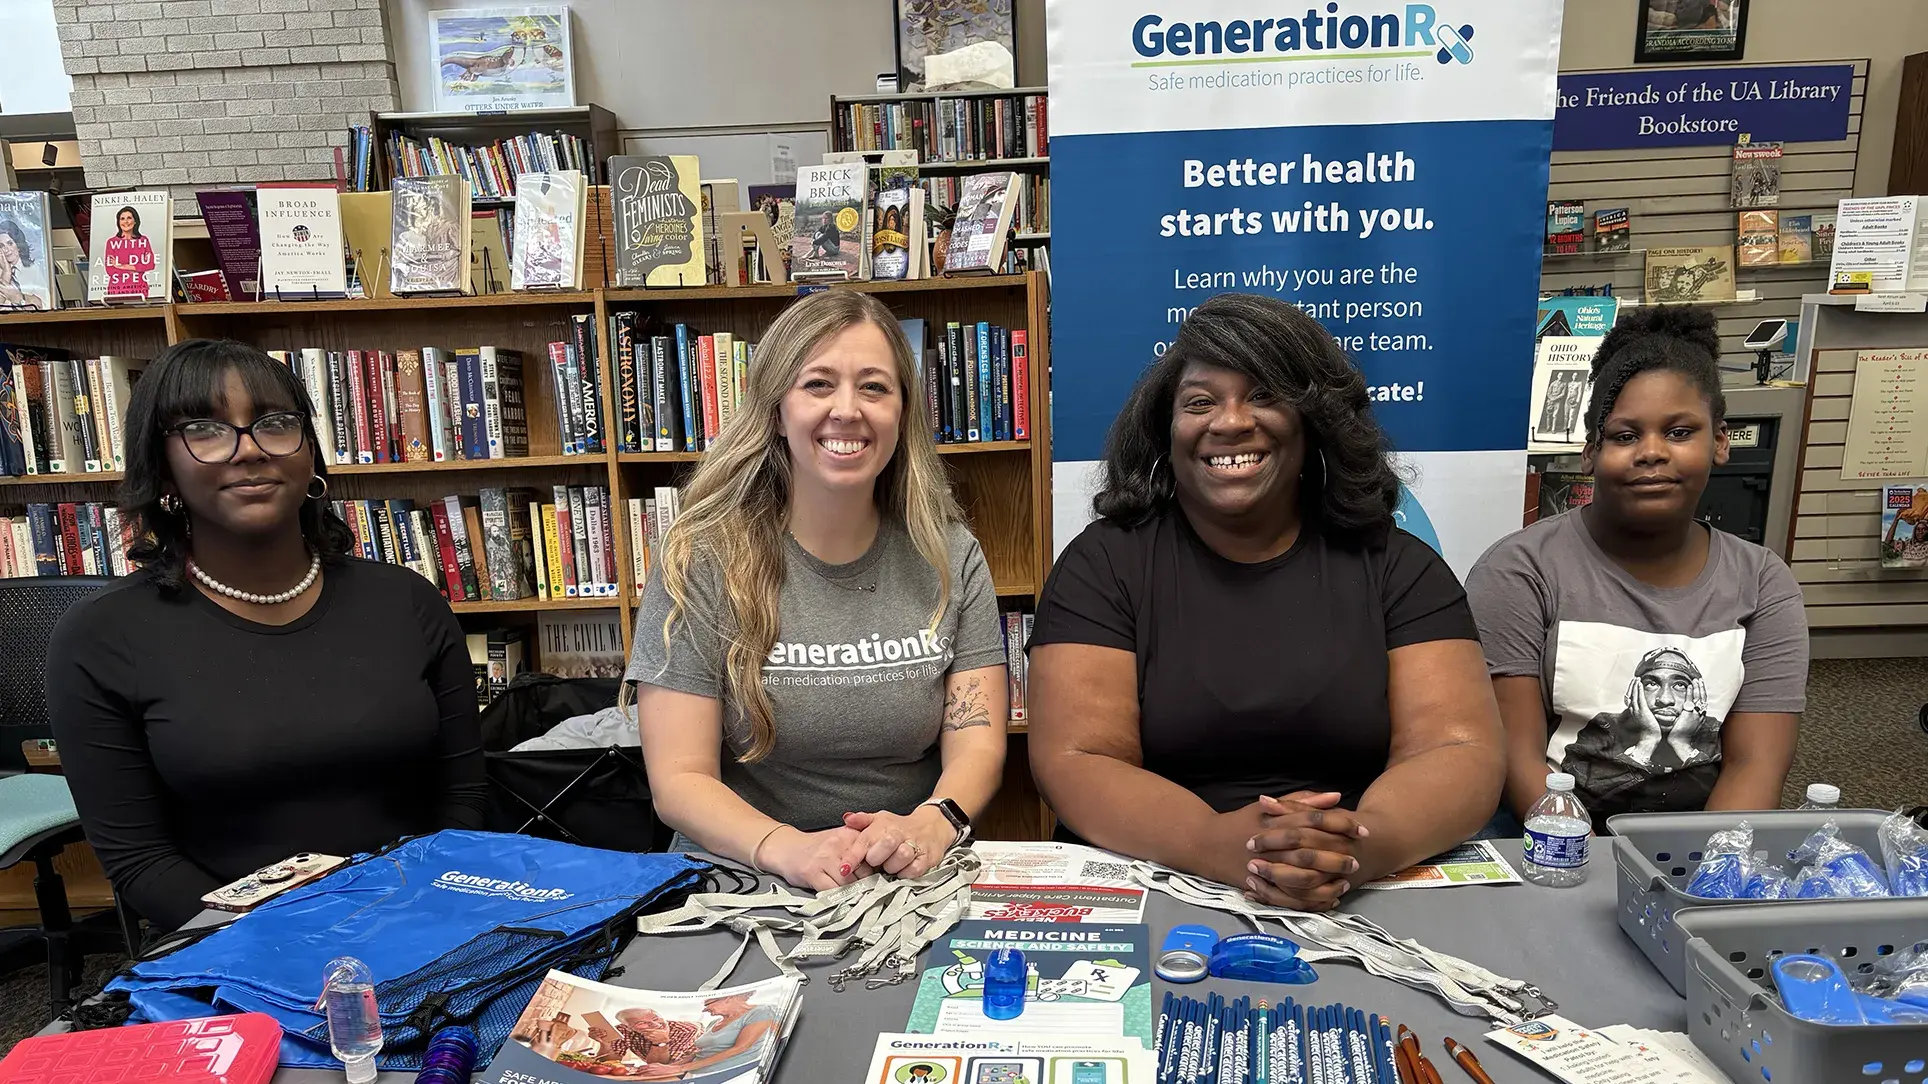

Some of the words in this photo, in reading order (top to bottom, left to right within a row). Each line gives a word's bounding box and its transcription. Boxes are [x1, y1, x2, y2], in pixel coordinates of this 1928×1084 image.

[1149, 72, 1184, 91] Safe
[1189, 69, 1283, 89] medication
[1288, 65, 1363, 88] practices
[1368, 65, 1391, 83] for
[1395, 64, 1424, 81] life.
[1555, 92, 1579, 108] he
[1586, 84, 1660, 108] Friends
[1666, 83, 1687, 103] of
[1691, 81, 1724, 103] the
[1730, 81, 1764, 101] UA
[1769, 80, 1841, 102] Library
[464, 103, 493, 111] OTTERS
[495, 102, 519, 110] UNDER
[520, 101, 544, 109] WATER
[1638, 115, 1738, 136] Bookstore
[810, 169, 852, 183] BRICK
[1183, 157, 1295, 188] Better
[1303, 152, 1416, 184] health
[618, 162, 674, 199] Dead
[94, 197, 121, 205] NIKKI
[134, 193, 165, 203] HALEY
[809, 185, 850, 199] BRICK
[265, 209, 332, 218] INFLUENCE
[278, 200, 317, 208] BROAD
[1549, 205, 1584, 216] Patterson
[620, 193, 686, 241] FEMINISTS
[1160, 208, 1263, 237] starts
[1271, 201, 1349, 233] with
[1359, 207, 1434, 239] you.
[1555, 215, 1578, 225] Lupica
[655, 222, 688, 234] HEROINES
[664, 233, 688, 241] color
[110, 239, 147, 250] WITH
[949, 241, 969, 250] CODES
[1557, 234, 1583, 243] MONTHS
[94, 255, 122, 267] ALL
[128, 253, 161, 266] DUE
[92, 271, 160, 285] RESPECT
[1174, 268, 1236, 289] Learn
[1242, 264, 1288, 291] why
[1293, 268, 1333, 291] you
[1340, 267, 1374, 284] are
[1380, 262, 1418, 284] the
[1346, 300, 1422, 323] person
[1575, 322, 1606, 330] Heritage
[702, 342, 711, 361] what
[950, 331, 958, 368] murder
[1370, 333, 1433, 351] team.
[1551, 344, 1578, 352] OHIO
[719, 351, 728, 366] THE
[980, 331, 989, 373] FORENSICS
[1548, 353, 1592, 362] HISTORY
[329, 359, 338, 372] THE
[656, 346, 665, 382] ASTRONAUT
[450, 364, 460, 388] BLOOD
[618, 323, 637, 426] ASTRONOMY
[720, 367, 730, 398] SECOND
[331, 376, 345, 421] AFGHANISTAN
[658, 383, 666, 404] MAKER
[1366, 382, 1424, 402] cate!
[371, 399, 380, 429] GROUND
[452, 392, 462, 426] TREASURE
[581, 379, 598, 438] AMERICA
[721, 400, 731, 426] CREAT
[968, 390, 977, 421] HANDBOOK
[105, 382, 115, 411] Between
[111, 425, 120, 450] Worlds
[492, 403, 500, 432] COUNTDOWN
[337, 422, 346, 448] PAPERS
[374, 431, 382, 451] ZERO
[1726, 430, 1752, 441] HERE
[1571, 485, 1593, 497] Myst
[1889, 495, 1910, 503] 2025
[572, 495, 583, 516] ONE
[575, 518, 586, 537] DAY
[589, 509, 599, 535] Dallas
[64, 532, 79, 555] ECHOES
[91, 530, 100, 544] The
[399, 522, 409, 544] SECRET
[404, 543, 412, 560] LIVES
[592, 536, 601, 554] 1963
[545, 624, 569, 653] THE
[572, 623, 606, 652] CIVIL
[610, 623, 622, 652] WA
[768, 628, 943, 664] enerationR
[761, 674, 780, 686] afe
[783, 674, 850, 686] medication
[853, 671, 904, 686] practices
[906, 668, 920, 679] for
[922, 664, 941, 677] life.
[971, 891, 1005, 899] Arling
[1007, 892, 1040, 900] Upper
[1044, 893, 1071, 901] Care
[1072, 894, 1137, 904] Outpatient
[983, 908, 1093, 918] BUCKEYES
[984, 930, 1102, 942] MEDICINE
[956, 940, 1028, 951] SCIENCE
[1030, 941, 1067, 951] AND
[1069, 942, 1127, 952] SAFETY
[1542, 1047, 1579, 1062] Medication
[1579, 1041, 1600, 1053] Safety
[1564, 1051, 1586, 1062] Patrol
[502, 1069, 537, 1084] SAFE
